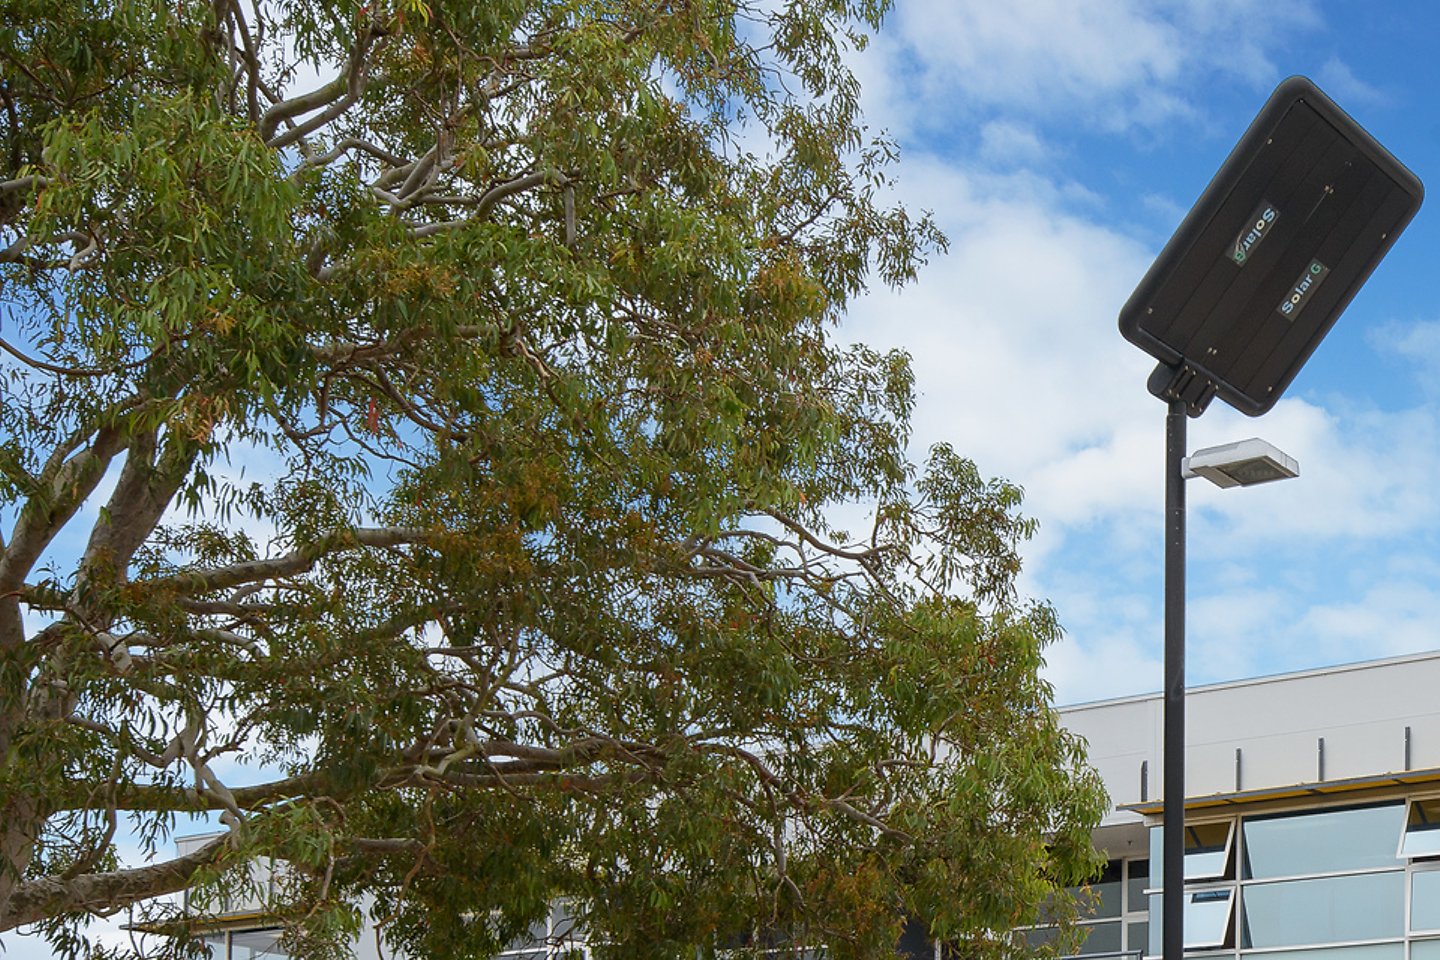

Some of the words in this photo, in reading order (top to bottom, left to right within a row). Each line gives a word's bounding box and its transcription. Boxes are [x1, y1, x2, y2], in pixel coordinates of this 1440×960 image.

[1242, 207, 1276, 251] Solar
[1235, 250, 1246, 262] G
[1281, 274, 1313, 314] Solar
[1310, 263, 1322, 275] G
